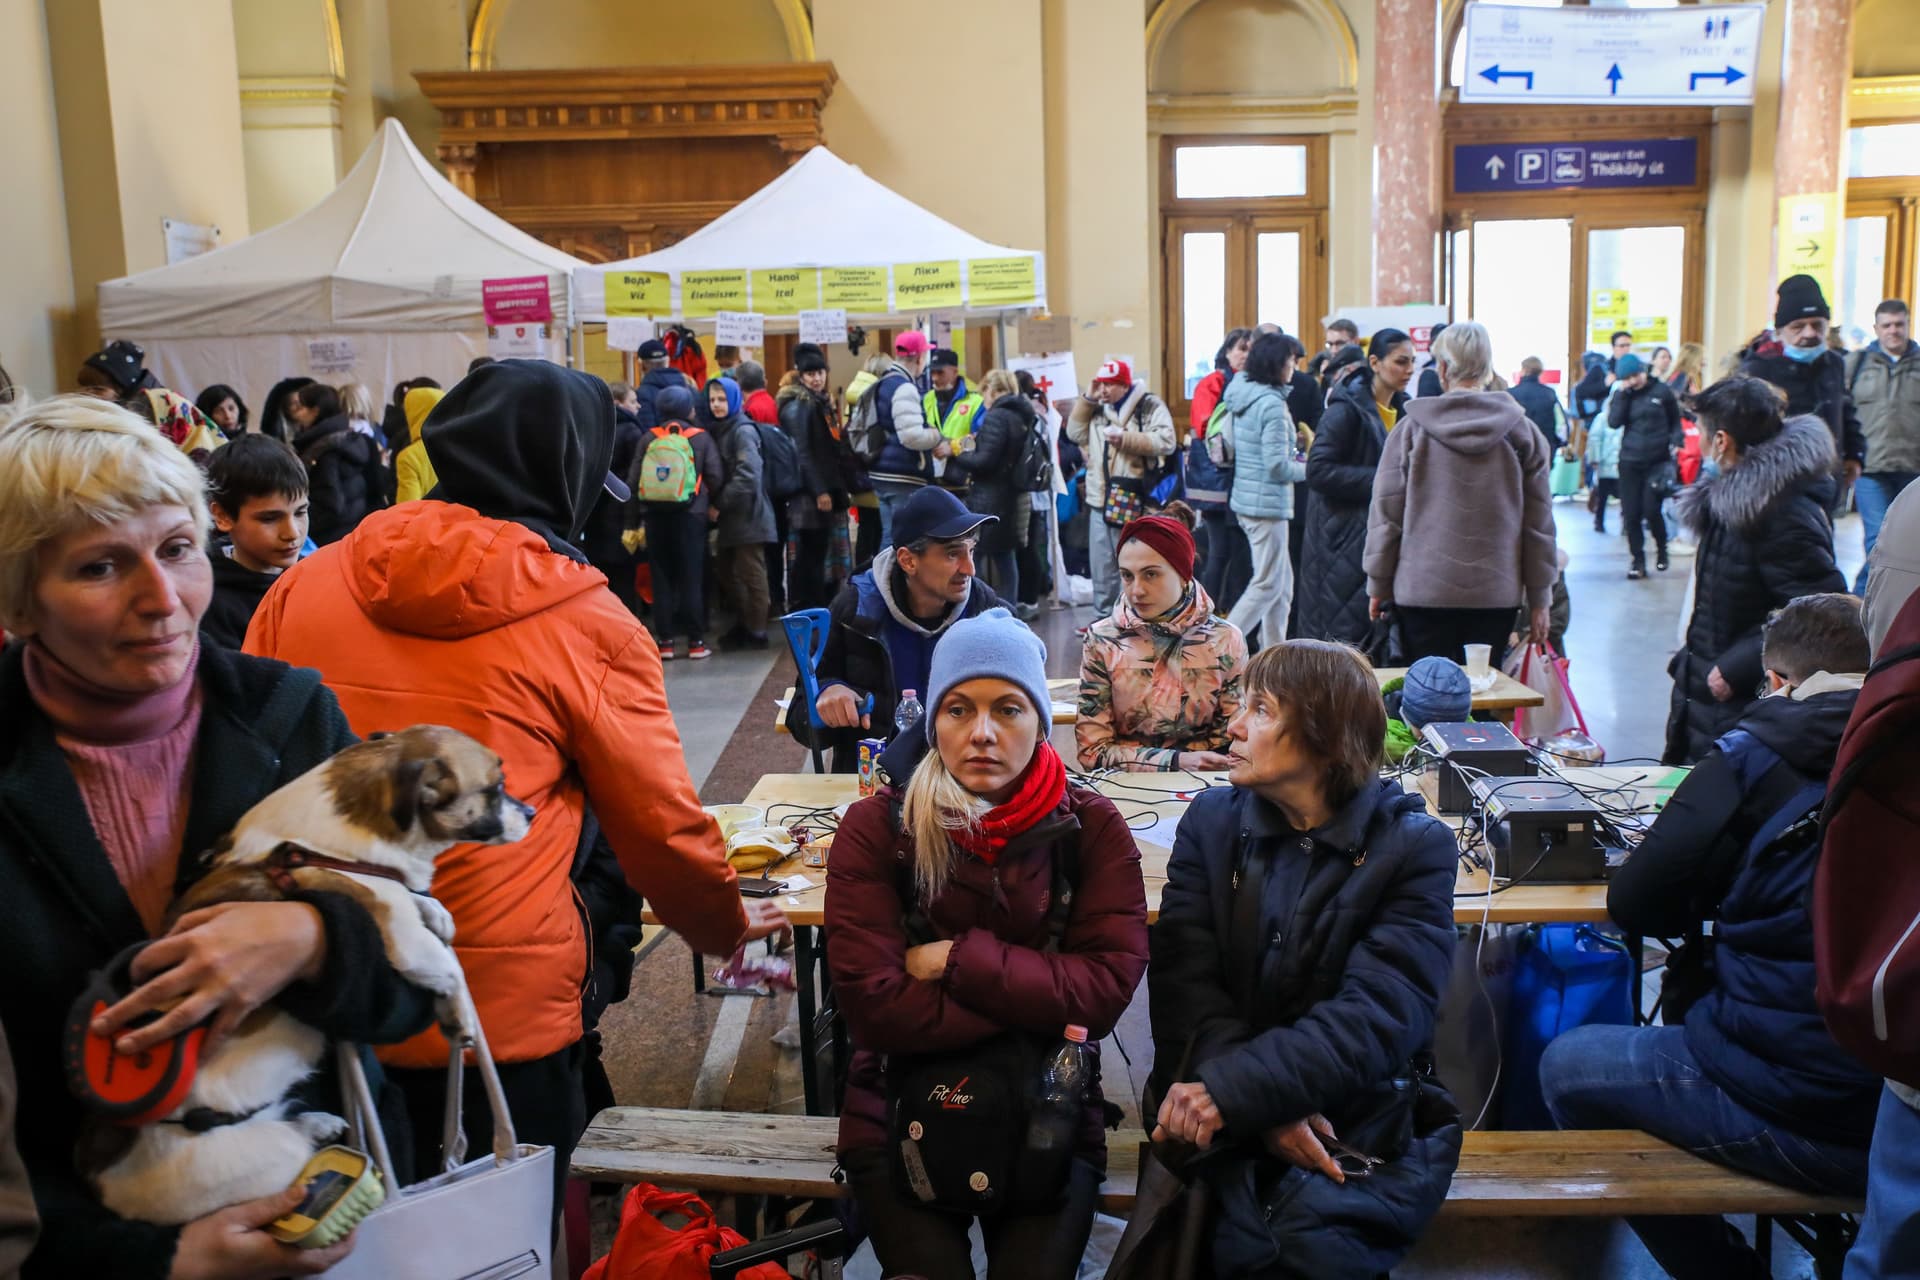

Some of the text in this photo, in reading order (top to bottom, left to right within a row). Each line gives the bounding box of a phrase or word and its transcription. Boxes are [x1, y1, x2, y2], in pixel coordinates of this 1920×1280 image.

[1521, 153, 1542, 180] P
[769, 272, 799, 282] Напої
[914, 266, 939, 277] Ліки
[623, 275, 652, 286] Вода
[686, 275, 742, 285] Харчування
[899, 281, 956, 296] Gyógyszerek
[927, 1076, 971, 1110] FitLine
